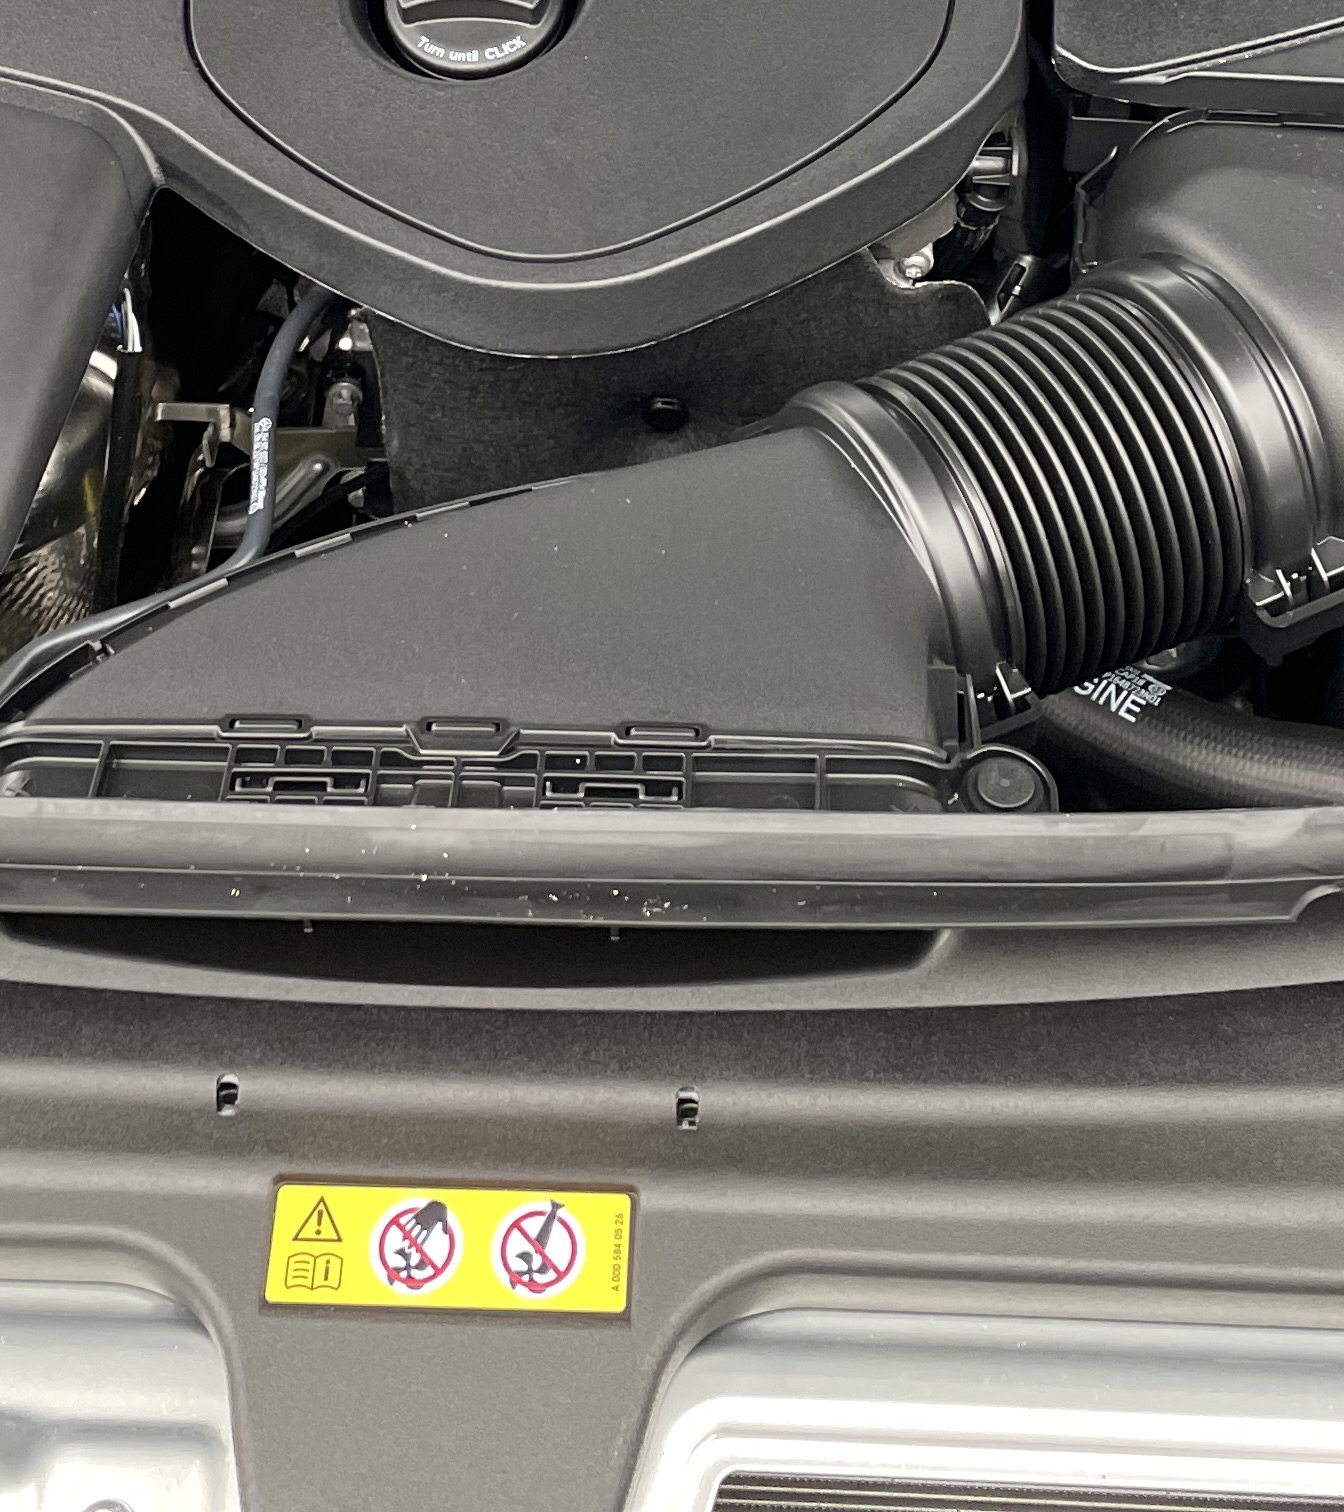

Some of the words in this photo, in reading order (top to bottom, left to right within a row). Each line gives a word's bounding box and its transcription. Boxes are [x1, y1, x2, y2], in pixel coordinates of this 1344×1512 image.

[417, 36, 445, 59] Turn
[449, 49, 479, 62] until
[485, 36, 527, 60] CLICK
